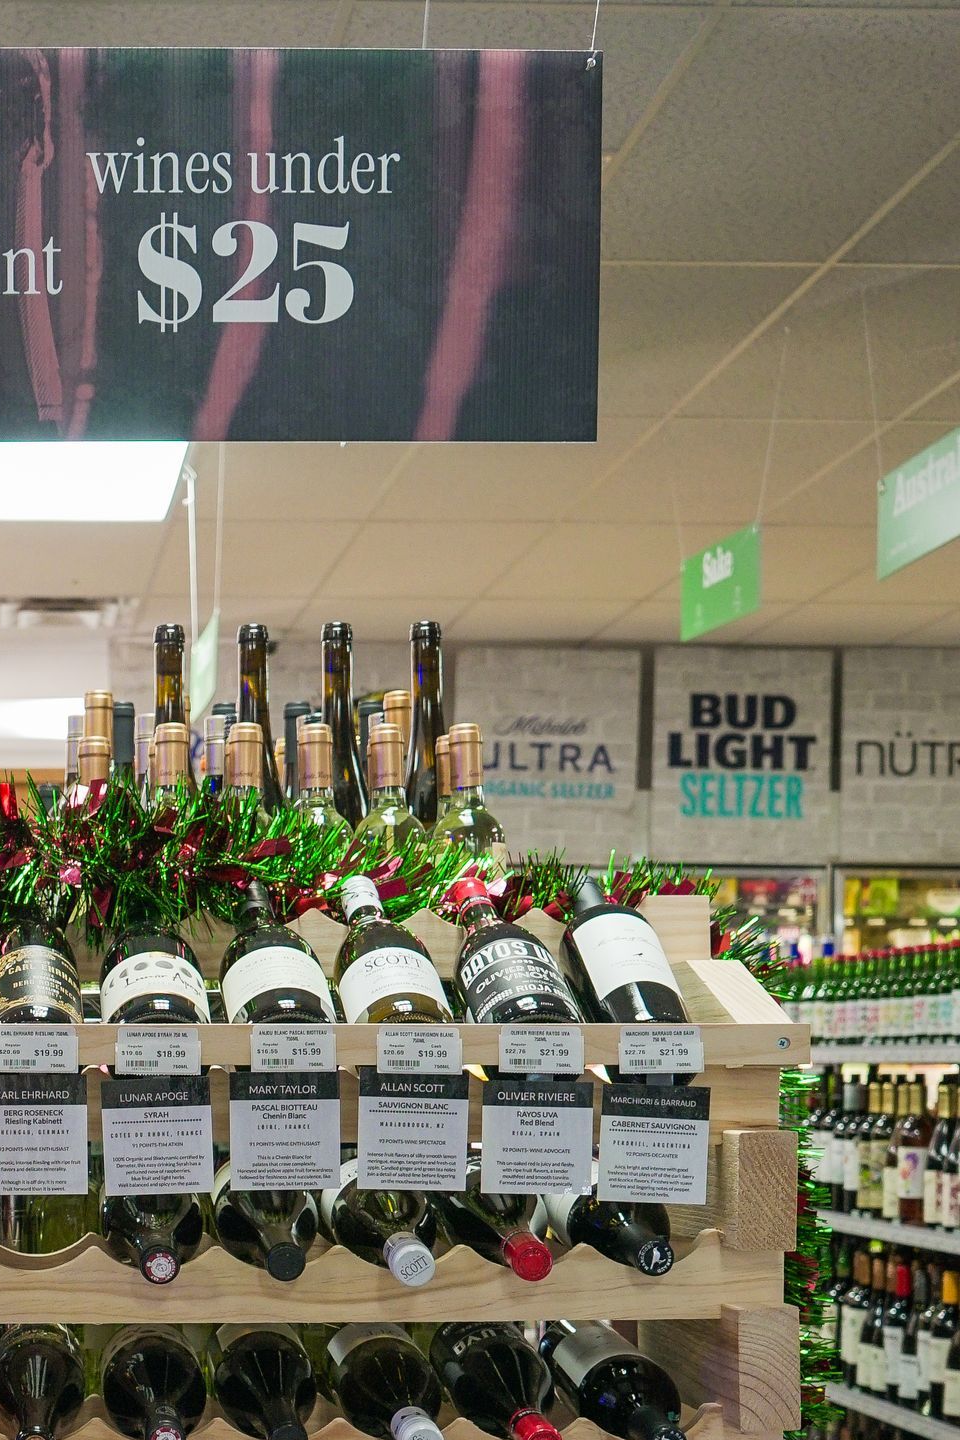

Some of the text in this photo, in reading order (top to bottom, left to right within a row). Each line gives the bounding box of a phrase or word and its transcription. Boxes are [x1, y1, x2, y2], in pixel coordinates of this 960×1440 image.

[87, 136, 400, 195] wines under
[137, 212, 355, 333] $25
[702, 545, 734, 589] Sake
[690, 692, 796, 729] BUD
[667, 732, 816, 770] LIGHT
[680, 771, 804, 818] SELTZER
[364, 954, 423, 972] SCOTT
[460, 940, 528, 988] RAYOS
[476, 965, 526, 994] OLIVIER
[516, 984, 552, 993] RIOJA
[418, 1050, 448, 1058] $19.99
[249, 1085, 317, 1094] MARY TAYLOR
[380, 1083, 445, 1093] ALLAN SCOTT
[22, 1090, 70, 1100] EHRHARD
[119, 1091, 189, 1102] LUNAR APOGE
[497, 1091, 575, 1102] OLIVIER RIVIERE
[378, 1102, 423, 1110] SAUVIGNON
[610, 1096, 653, 1106] MARCHIORI
[661, 1098, 696, 1108] BARRAUD
[5, 1117, 62, 1126] Riesling Kabinett
[612, 1120, 696, 1131] CABERNET SAUVIGNON
[400, 1256, 428, 1280] SCOTT
